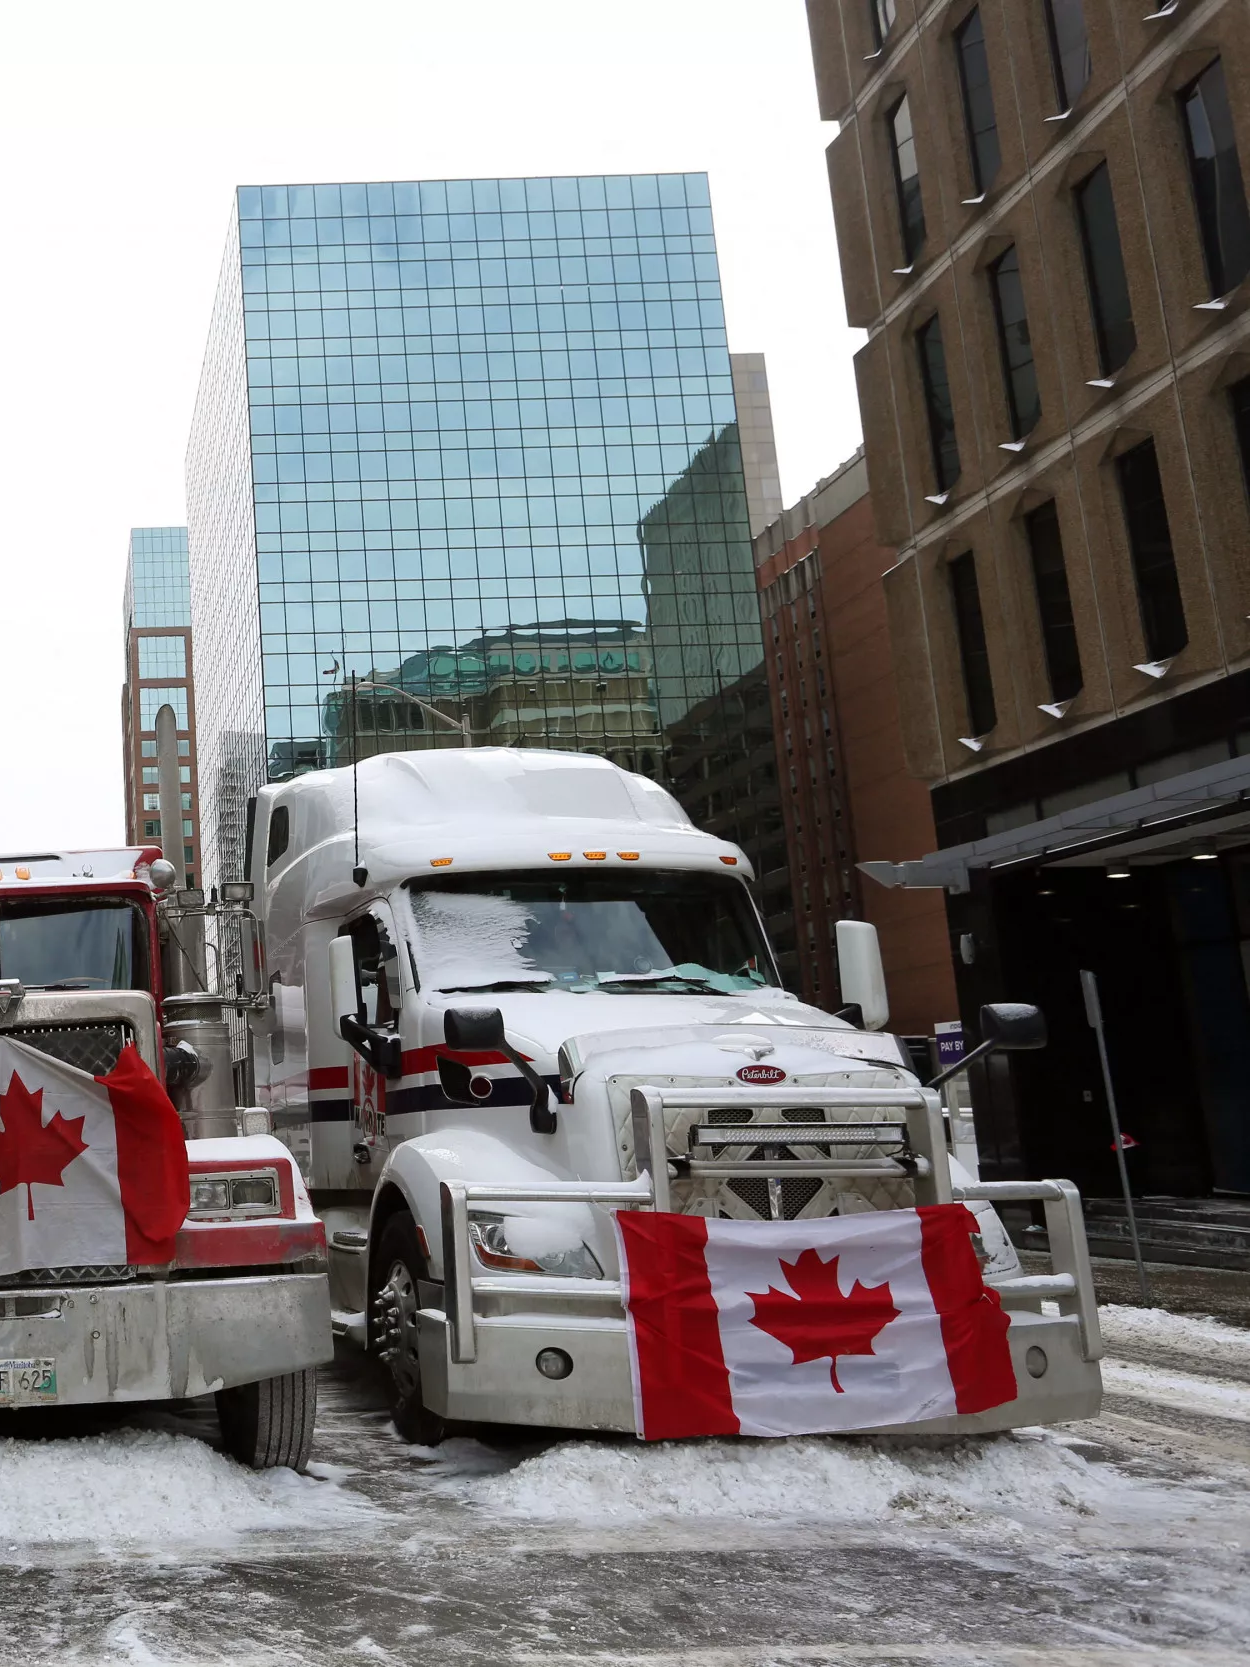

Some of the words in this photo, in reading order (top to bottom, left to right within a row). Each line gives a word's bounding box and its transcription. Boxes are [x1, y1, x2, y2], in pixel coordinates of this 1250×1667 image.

[940, 1041, 954, 1052] PAY
[954, 1040, 964, 1051] BY
[741, 1068, 781, 1080] Peterbilt
[19, 1369, 52, 1392] 625
